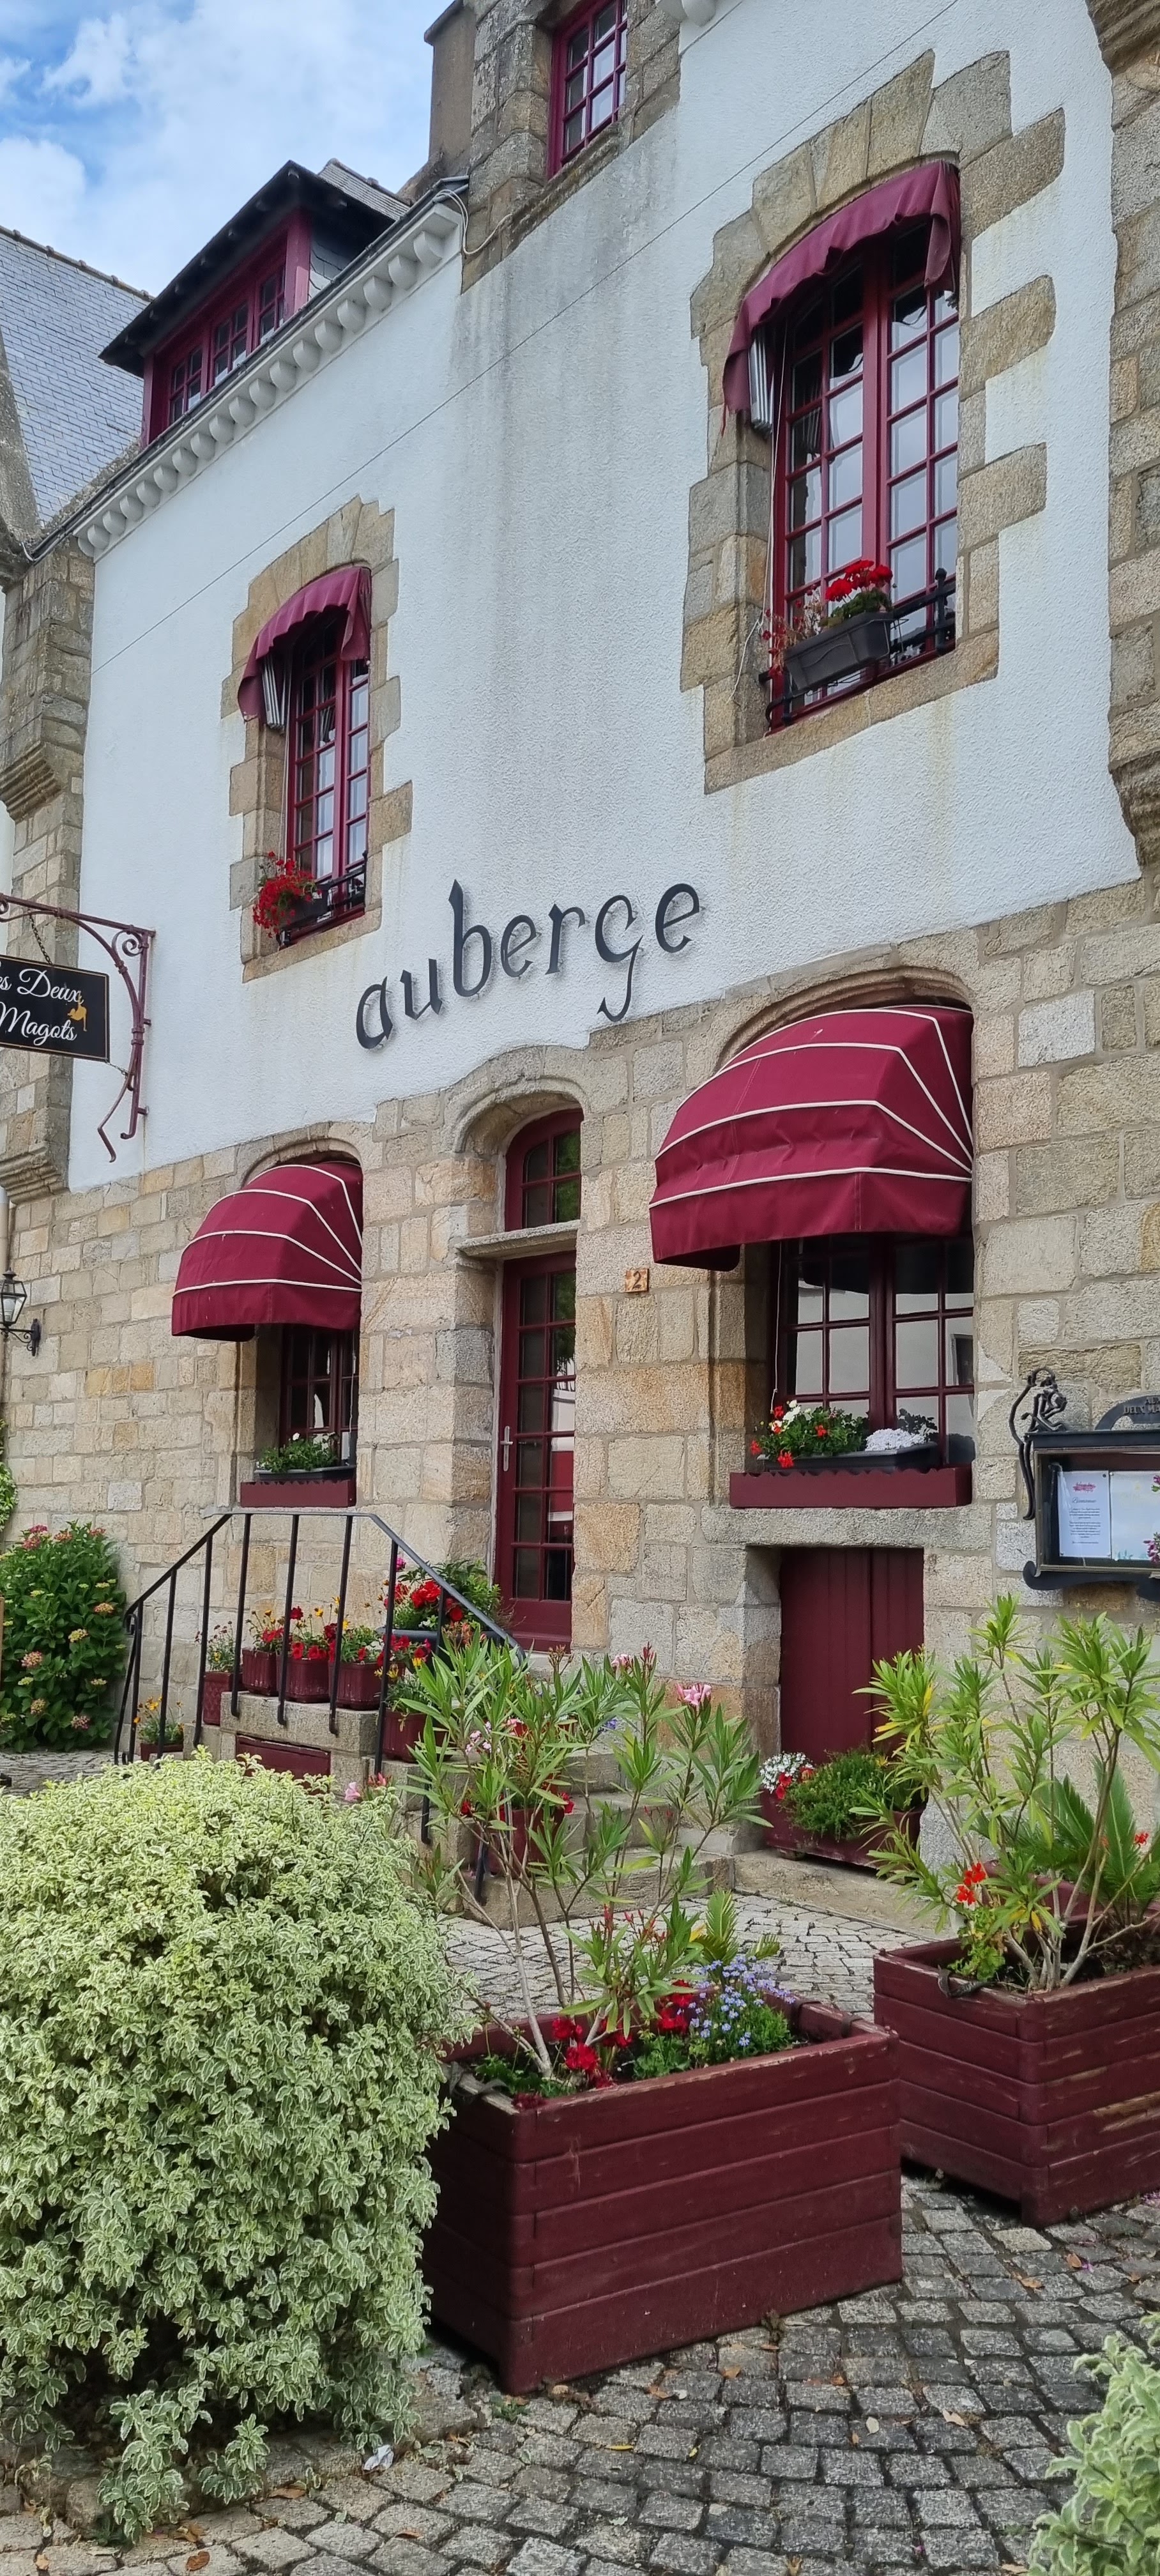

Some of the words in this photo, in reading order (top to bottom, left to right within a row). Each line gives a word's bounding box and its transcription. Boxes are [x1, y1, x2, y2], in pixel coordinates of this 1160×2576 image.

[356, 879, 700, 1049] auberge
[17, 969, 84, 1005] Deux
[0, 1001, 77, 1046] Magots
[632, 1270, 642, 1291] 2
